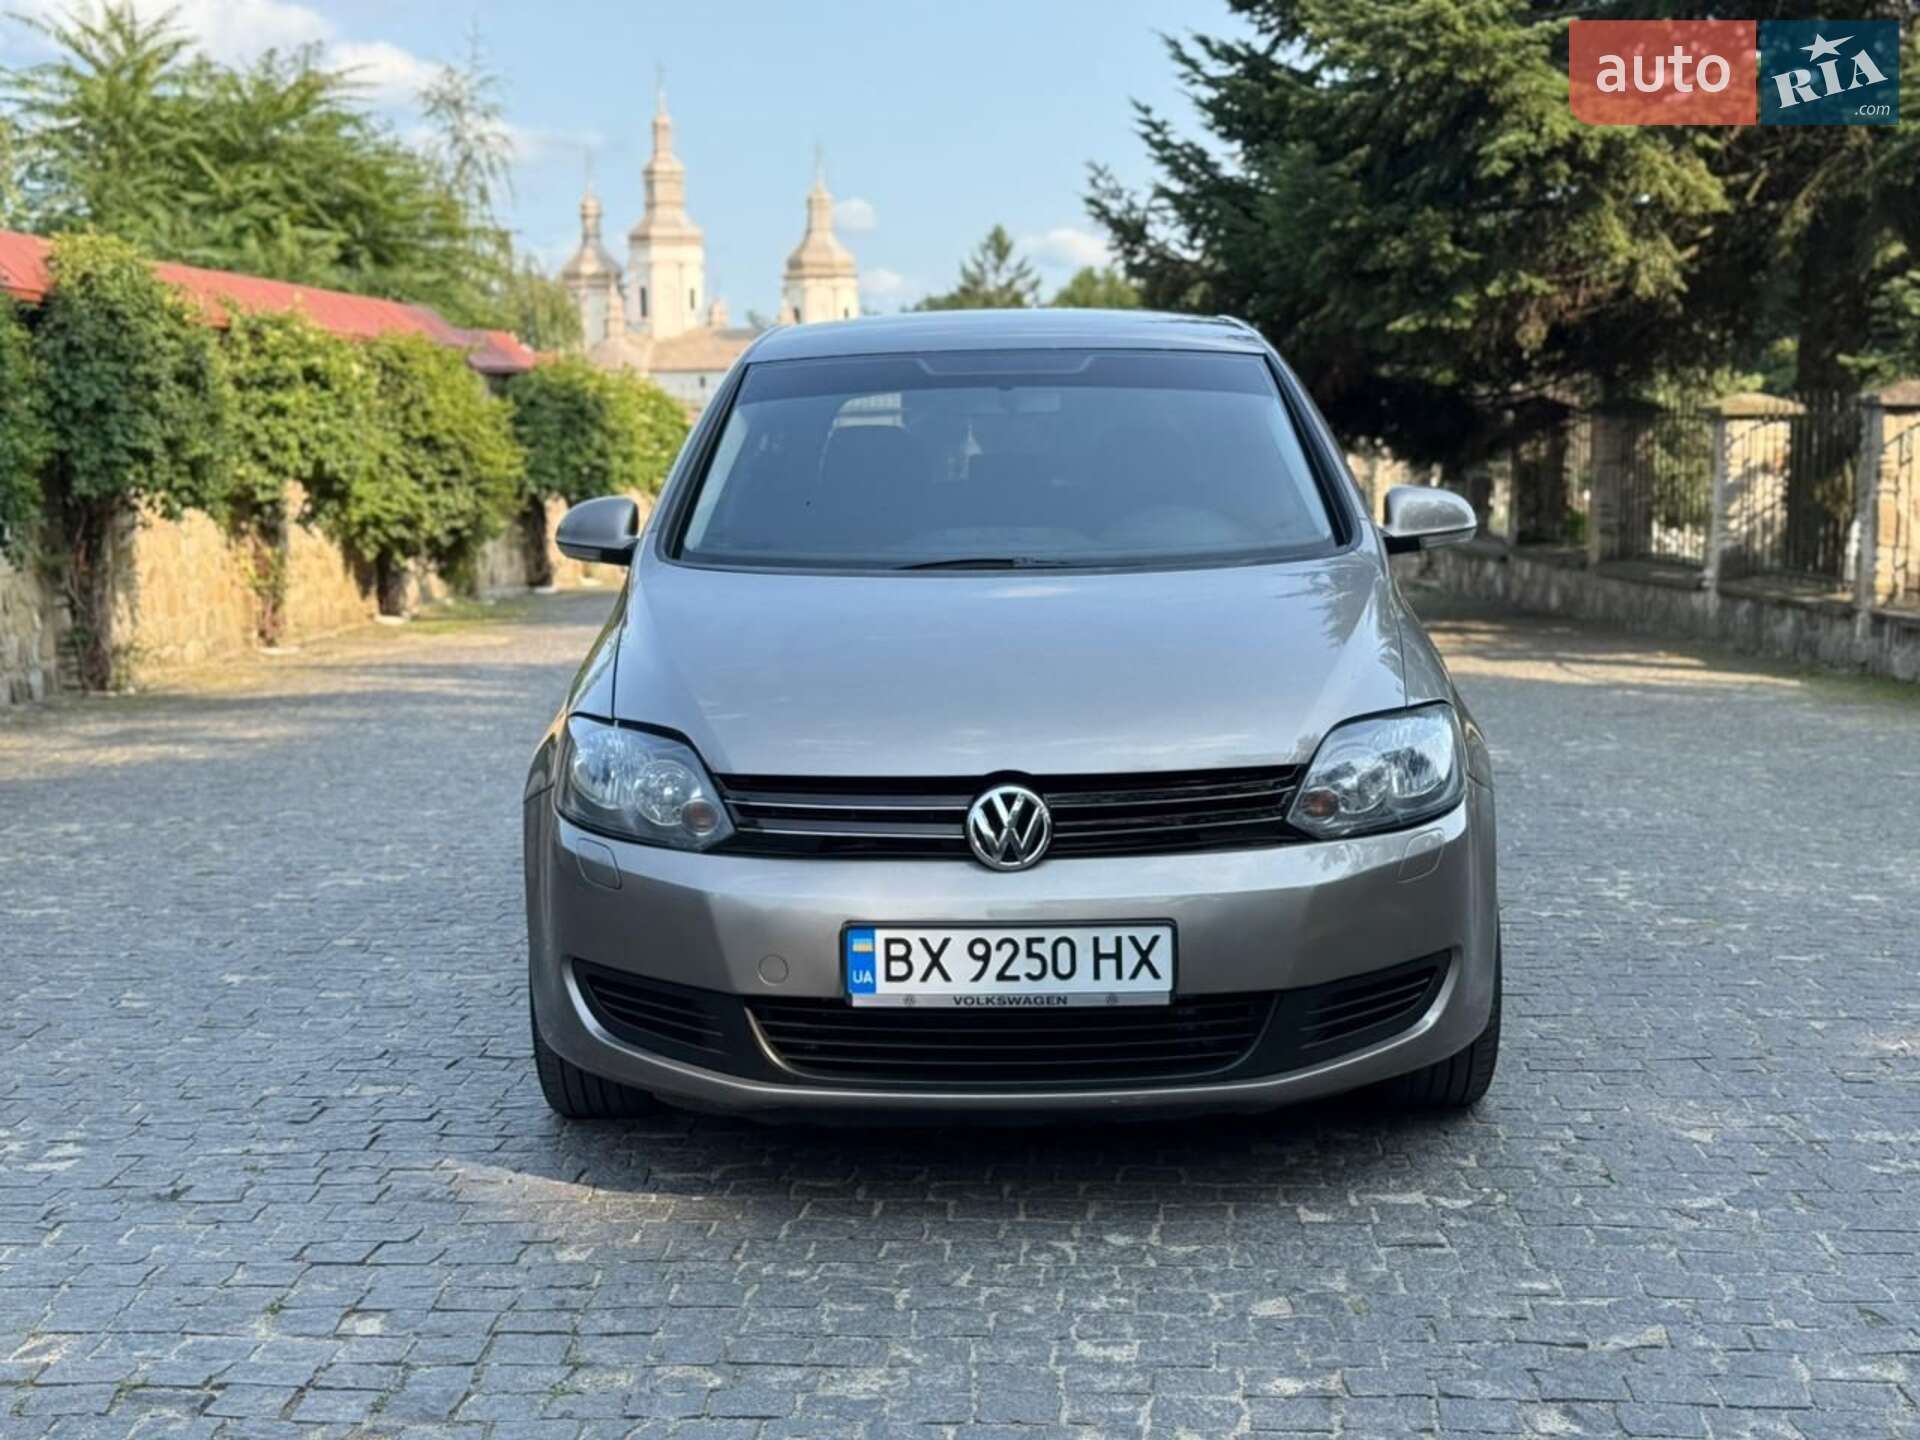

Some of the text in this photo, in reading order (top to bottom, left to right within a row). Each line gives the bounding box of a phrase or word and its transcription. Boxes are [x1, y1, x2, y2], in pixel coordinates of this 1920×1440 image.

[884, 935, 1162, 983] BX 9250 HX
[852, 970, 874, 984] UA
[953, 995, 1068, 1007] VOLKSWAGEN
